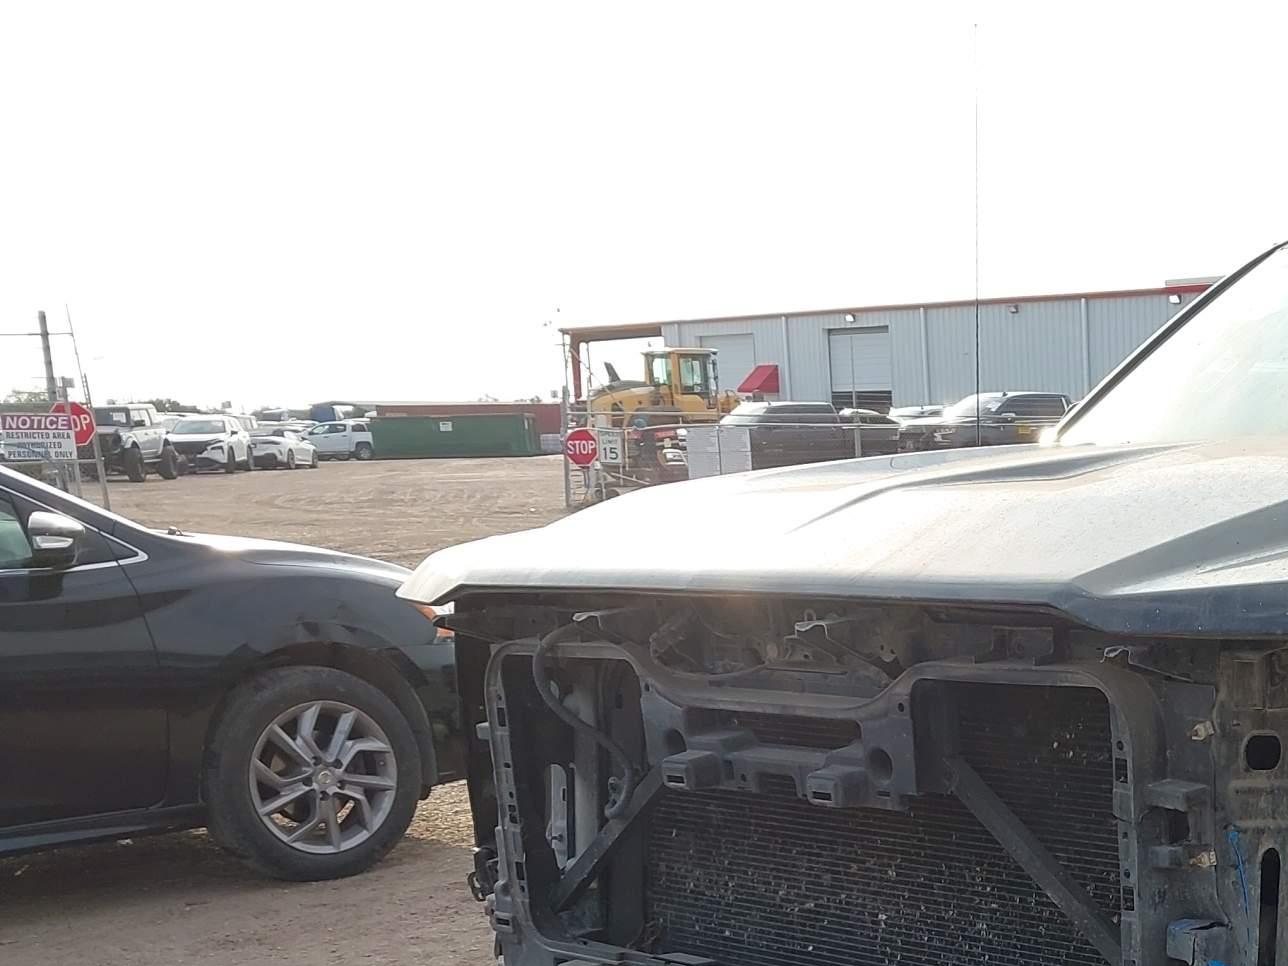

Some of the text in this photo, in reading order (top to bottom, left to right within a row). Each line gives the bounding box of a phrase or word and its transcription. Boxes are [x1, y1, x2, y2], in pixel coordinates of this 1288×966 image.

[5, 416, 69, 429] NOTICE
[6, 432, 71, 440] RESTRICTED AREA
[567, 440, 596, 455] STOP
[603, 447, 619, 461] 15
[54, 450, 73, 459] ONLY
